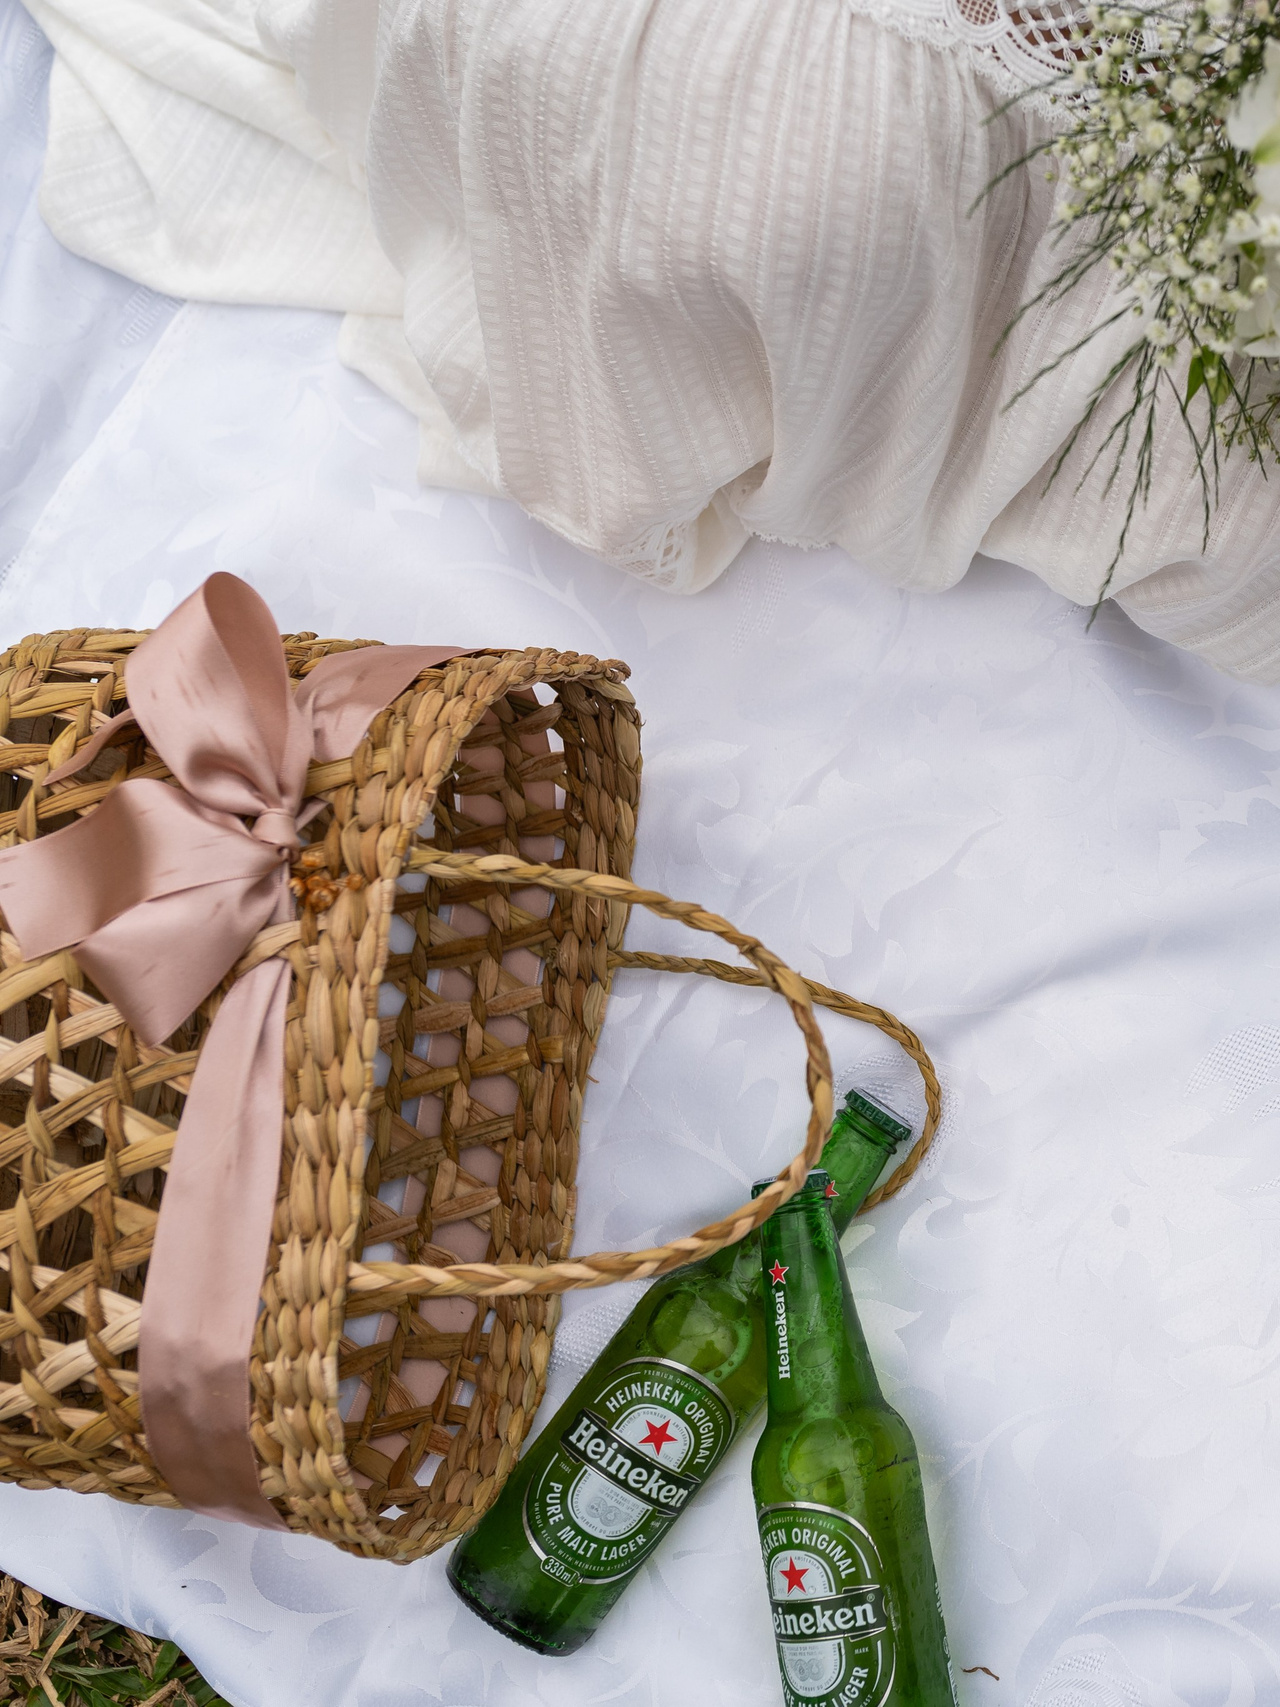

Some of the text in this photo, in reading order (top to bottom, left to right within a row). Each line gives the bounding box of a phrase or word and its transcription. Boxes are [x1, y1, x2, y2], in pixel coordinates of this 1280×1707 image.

[774, 1290, 791, 1380] Heineken
[605, 1381, 715, 1465] HEINEKEN ORIGINAL
[568, 1416, 690, 1508] Heineken
[540, 1529, 558, 1550] RECIPE
[557, 1549, 572, 1563] WITH
[546, 1481, 647, 1561] PURE MALT LAGER
[791, 1527, 857, 1580] ORIGINAL
[544, 1558, 577, 1584] 330ml
[773, 1602, 878, 1636] eineken
